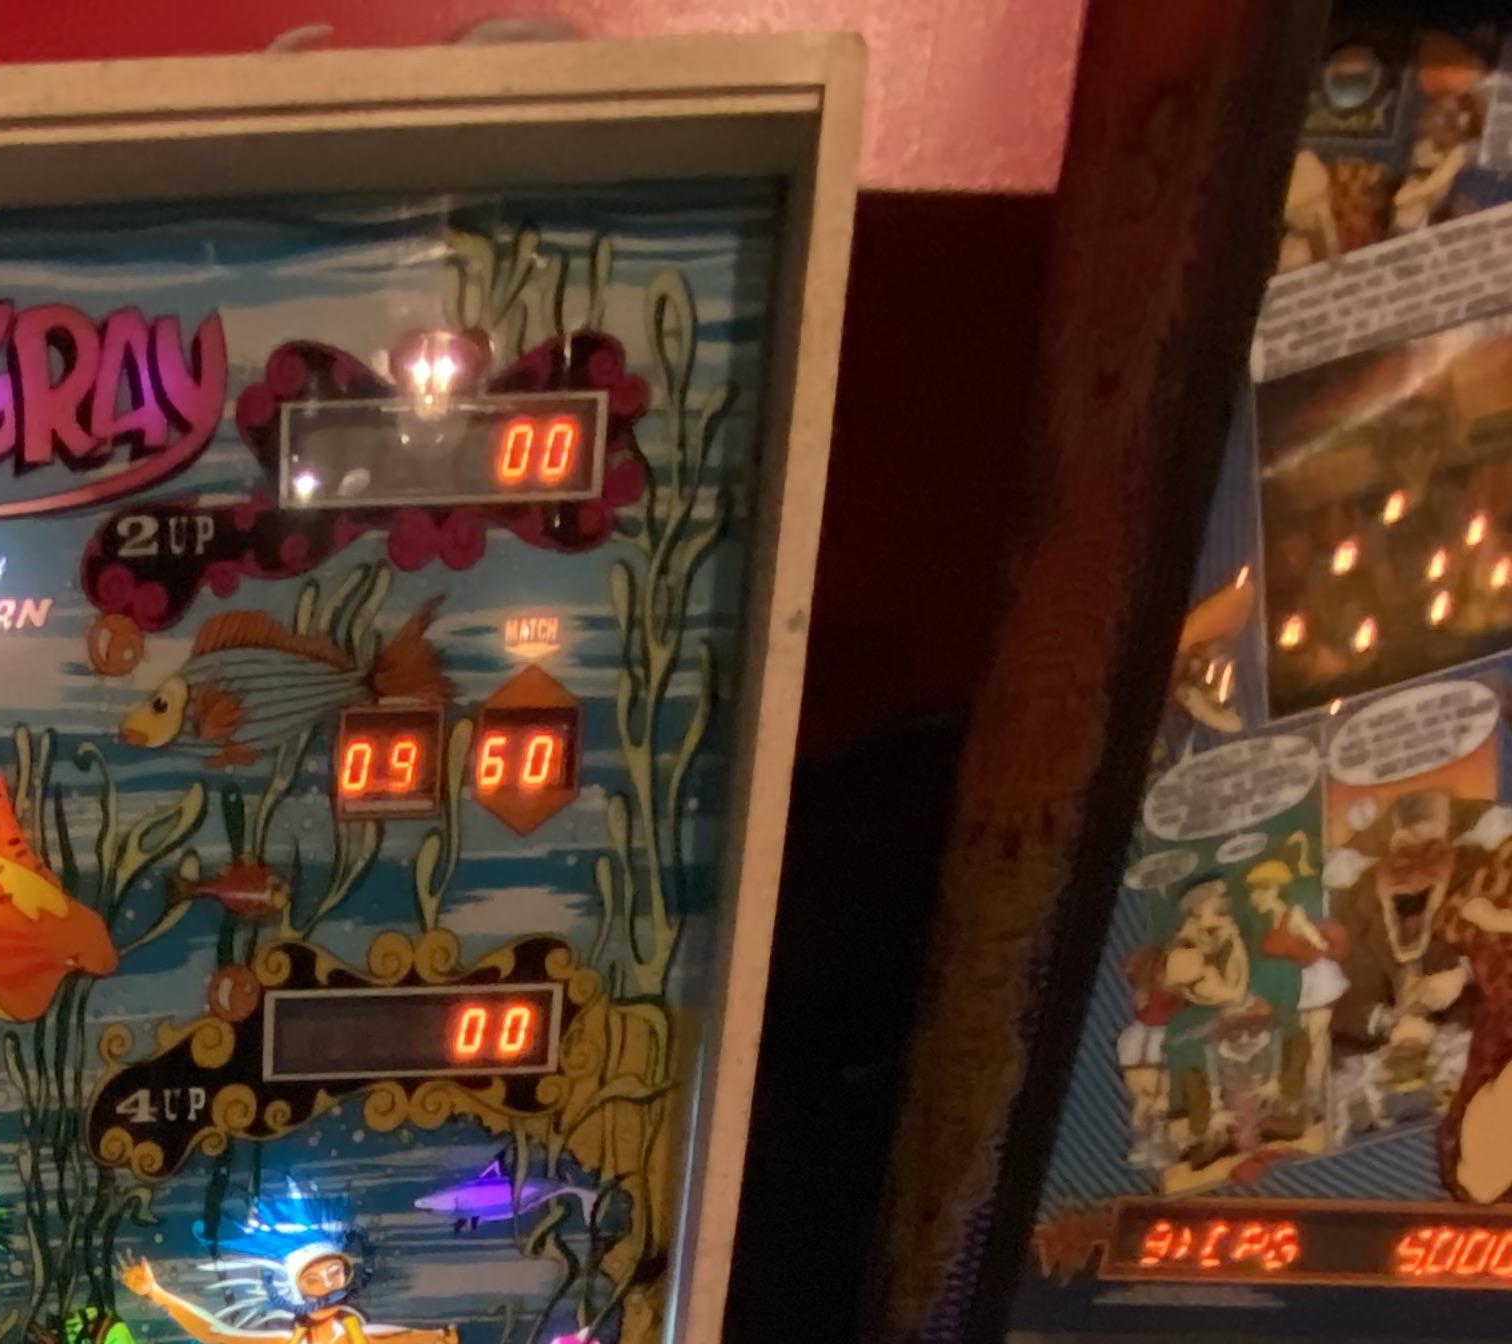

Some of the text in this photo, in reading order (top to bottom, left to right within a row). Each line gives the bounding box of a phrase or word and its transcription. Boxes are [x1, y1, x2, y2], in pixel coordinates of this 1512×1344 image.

[497, 416, 579, 484] 00
[117, 512, 215, 558] 2 UP
[505, 617, 559, 642] MATCH
[340, 739, 421, 792] 09
[477, 736, 558, 786] 60
[455, 1007, 533, 1058] 00
[115, 1089, 206, 1123] 4 UP
